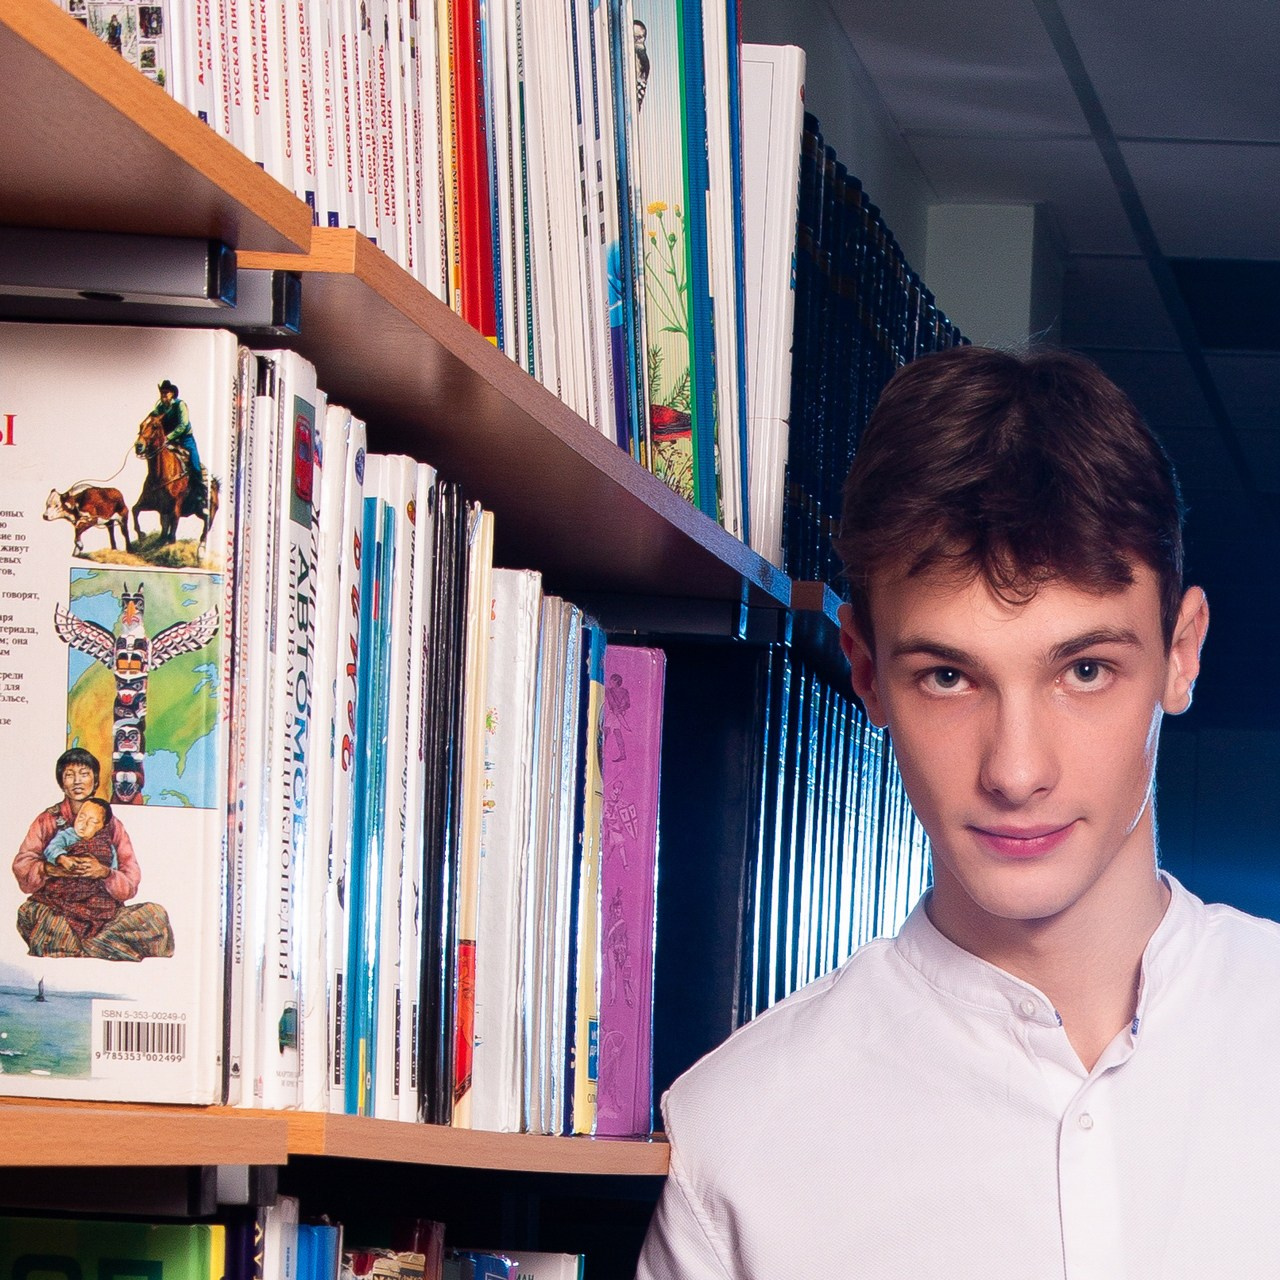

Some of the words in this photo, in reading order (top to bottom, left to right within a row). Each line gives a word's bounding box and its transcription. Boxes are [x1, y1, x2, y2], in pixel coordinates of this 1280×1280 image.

[221, 32, 230, 134] СЛАВЯНСКАЯ
[232, 36, 240, 106] РУССКАЯ
[284, 79, 292, 158] Северная
[379, 45, 387, 128] КАЛЕНДАРЬ
[301, 79, 311, 175] АЛЕКСАНДР
[326, 126, 335, 168] Герои
[344, 86, 352, 193] КУЛИКОВСКАЯ
[356, 80, 364, 178] РОССИЙСКИЙ
[382, 135, 390, 216] НАРОДНЫЙ
[265, 429, 274, 632] ПИСЬМЕННОСТЬ
[2, 592, 40, 600] говорят,
[224, 529, 233, 639] НАРОДЫ
[242, 523, 250, 663] АСТРОНОМИЯ
[286, 541, 297, 697] МИРОВАЯ
[4, 683, 20, 691] для
[223, 654, 231, 722] МИРА
[342, 527, 361, 781] Земля
[278, 711, 292, 981] ЭНЦИКЛОПЕДИЯ
[235, 839, 243, 965] ЭНЦИКЛОПЕДИЯ
[102, 1010, 122, 1018] ISBN
[124, 1011, 186, 1021] 5-353-00249-0
[105, 1053, 141, 1061] 785353
[146, 1054, 182, 1062] 002499
